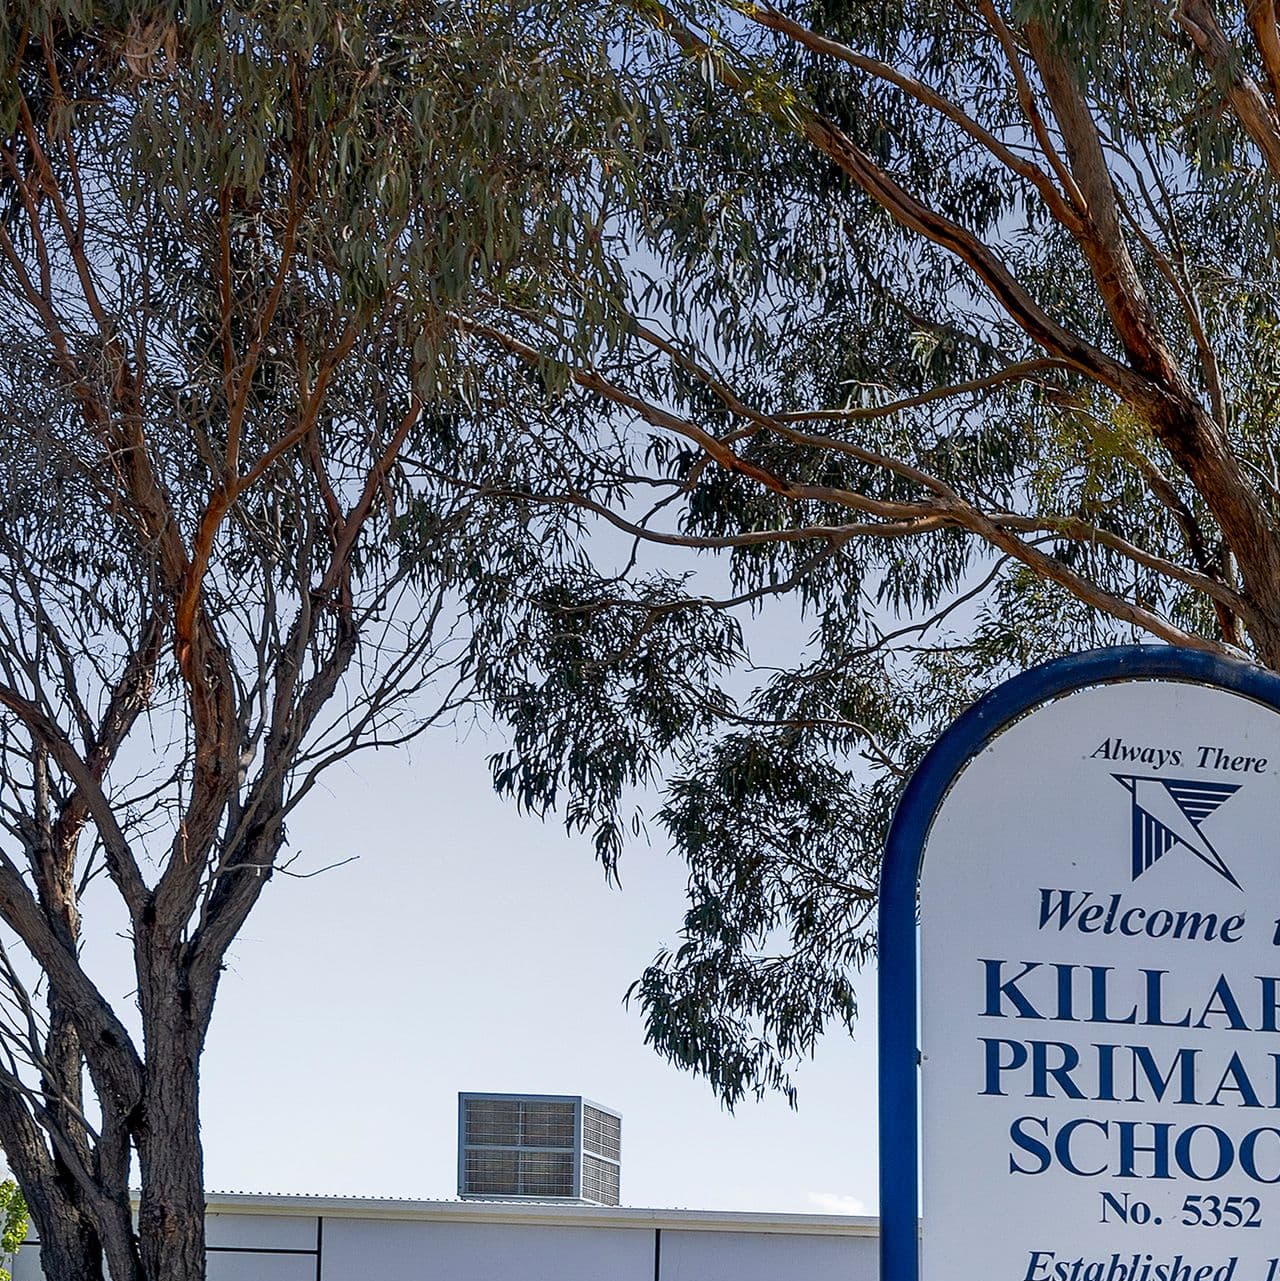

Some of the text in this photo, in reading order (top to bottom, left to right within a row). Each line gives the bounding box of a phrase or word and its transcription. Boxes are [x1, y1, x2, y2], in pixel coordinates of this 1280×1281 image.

[1090, 737, 1268, 773] Always There
[1038, 888, 1246, 943] Welcome
[1099, 1192, 1263, 1228] No. 5352
